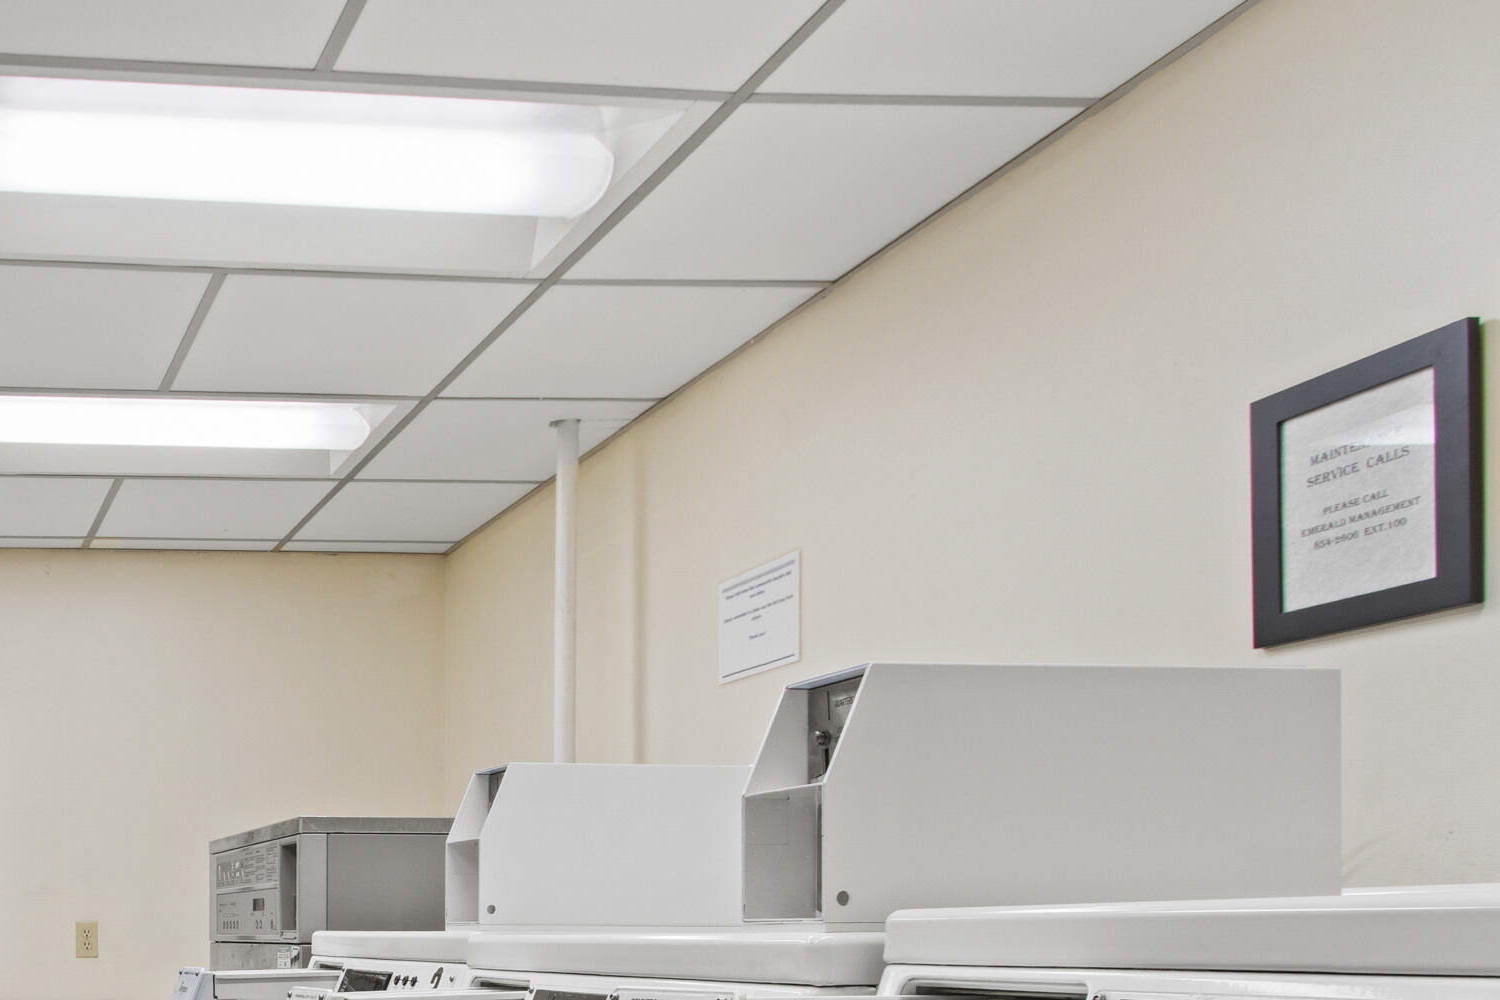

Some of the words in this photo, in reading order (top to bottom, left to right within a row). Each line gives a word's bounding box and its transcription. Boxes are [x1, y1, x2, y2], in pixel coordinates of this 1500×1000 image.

[1306, 461, 1360, 488] SERVICE
[1366, 445, 1411, 469] CALLS
[1301, 518, 1347, 538] EMERALD
[1348, 495, 1421, 525] MANAGEMENT
[1323, 496, 1361, 515] PLEASE
[1362, 488, 1390, 504] CALL
